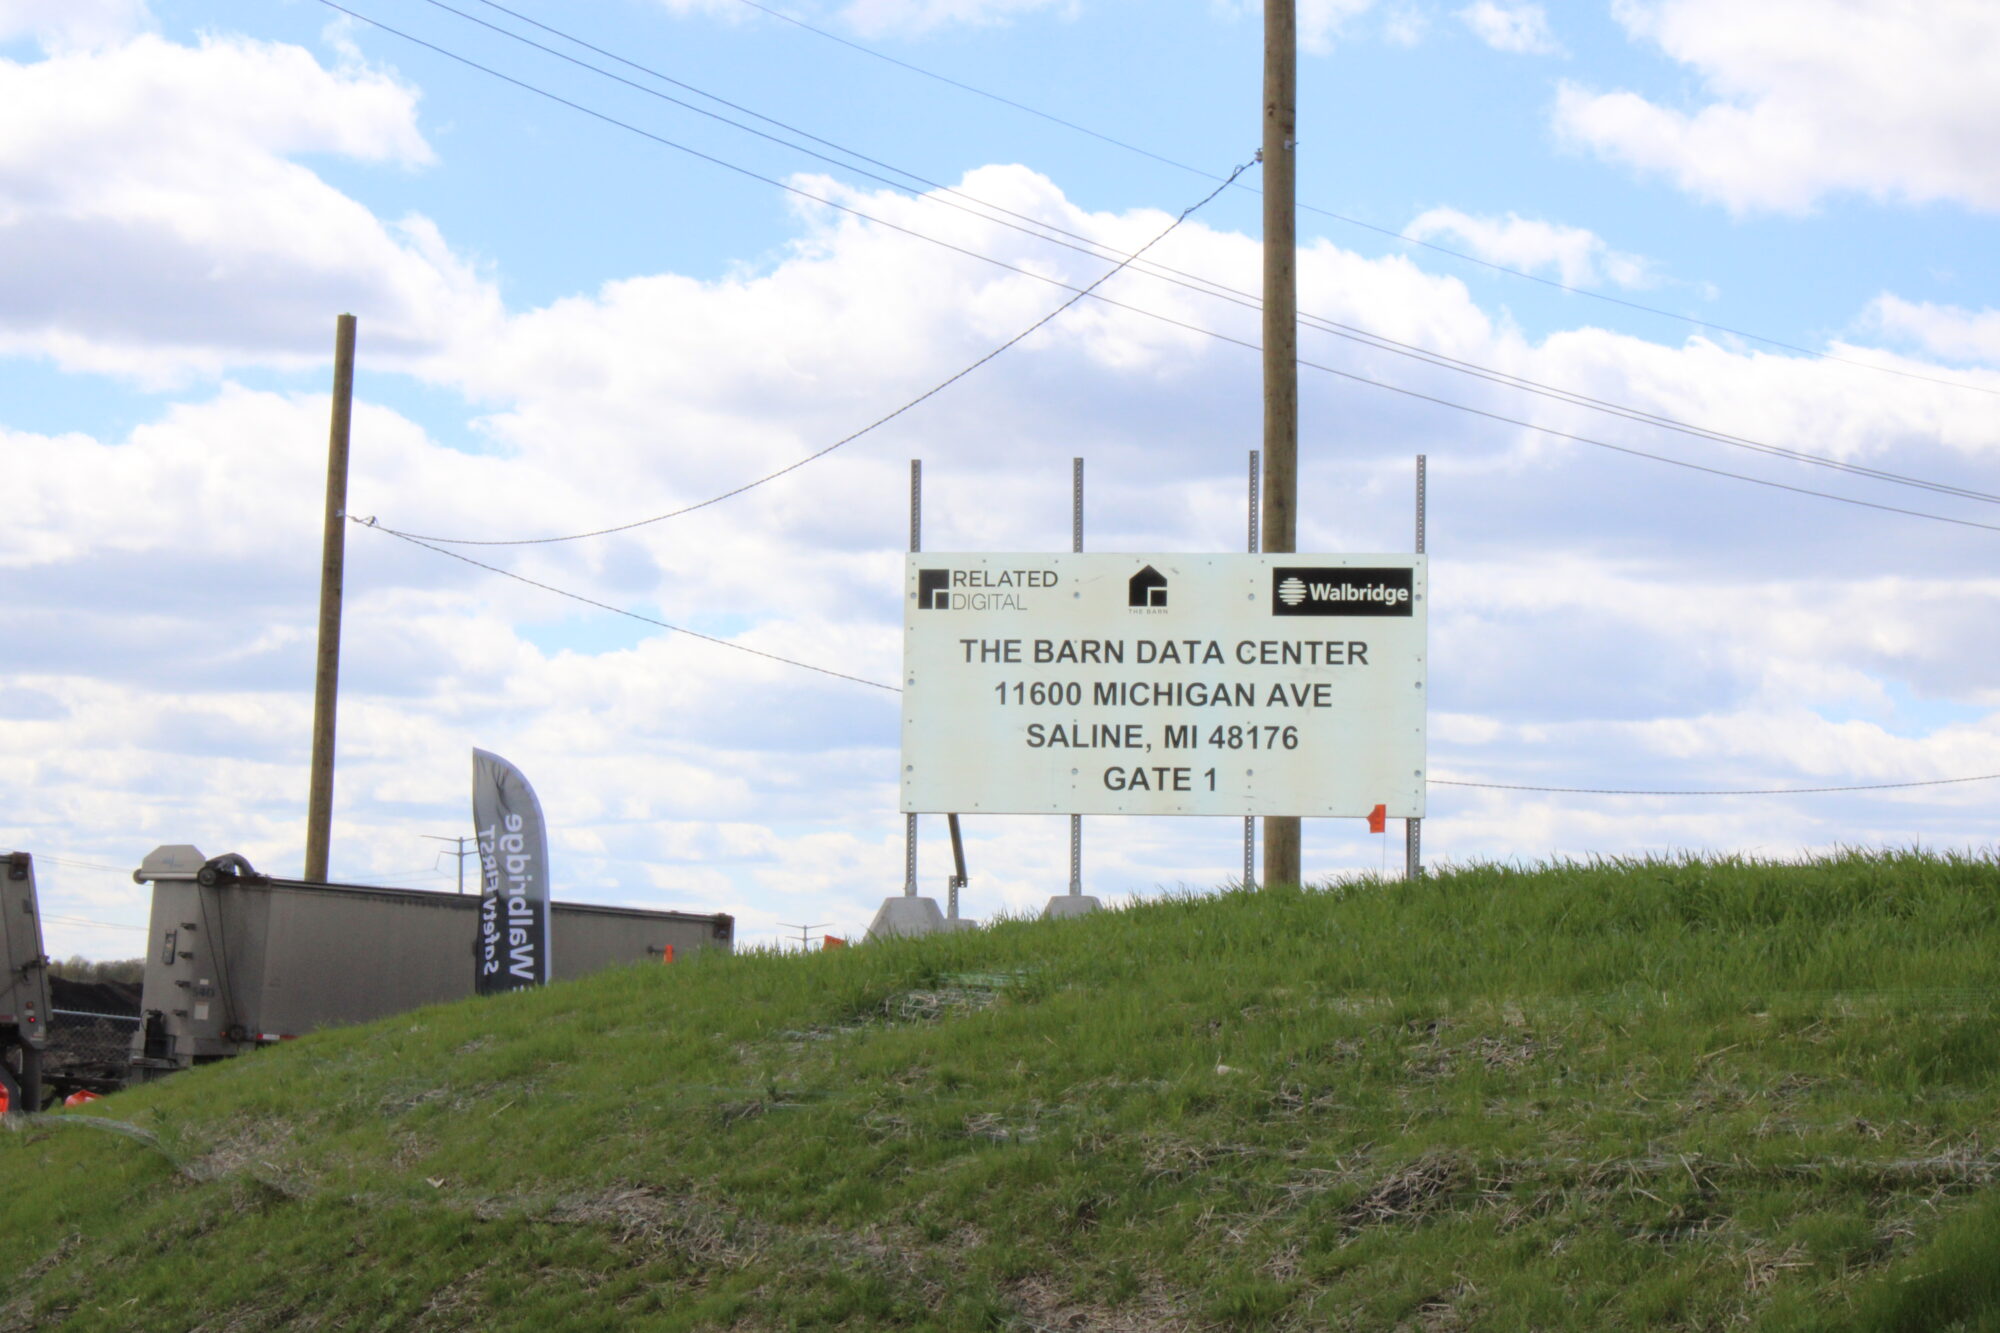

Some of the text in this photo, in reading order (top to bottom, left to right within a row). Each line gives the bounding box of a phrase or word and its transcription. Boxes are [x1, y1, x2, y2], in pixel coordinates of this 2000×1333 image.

[953, 570, 1059, 587] RELATED
[952, 592, 1028, 611] DIGITAL
[1309, 583, 1409, 606] Walbridge
[959, 639, 1369, 666] THE BARN DATA CENTER
[995, 681, 1333, 708] 11600 MICHIGAN AVE
[1026, 723, 1299, 753] SALINE, MI 48176
[1103, 766, 1216, 792] GATE 1
